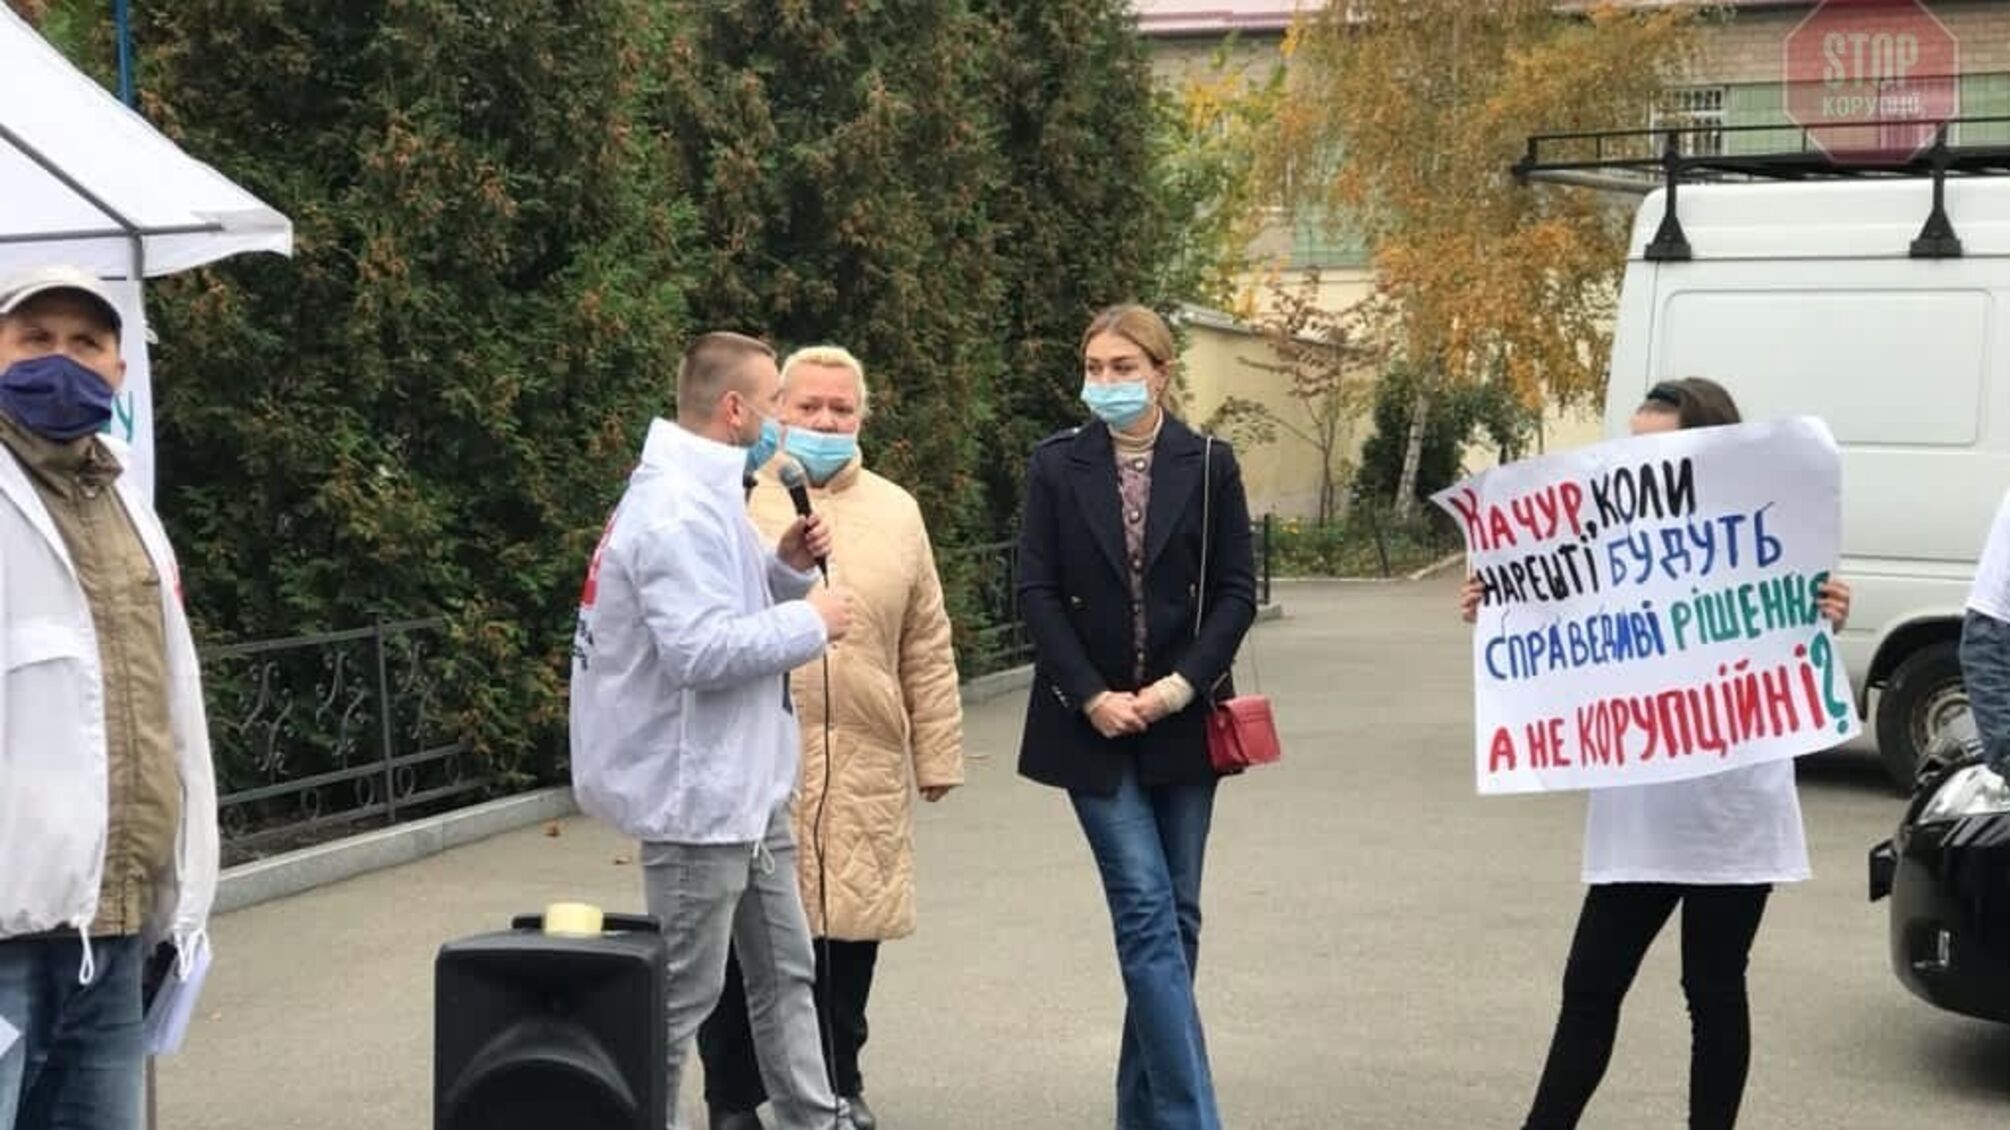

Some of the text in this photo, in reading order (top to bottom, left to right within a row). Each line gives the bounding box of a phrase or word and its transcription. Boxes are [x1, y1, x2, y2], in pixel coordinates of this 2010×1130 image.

[1591, 457, 1696, 529] КОЛИ
[1476, 502, 1782, 606] НАРЕШТІ БУДУТЬ
[1489, 726, 1517, 772] А
[1526, 717, 1571, 769] НЕ
